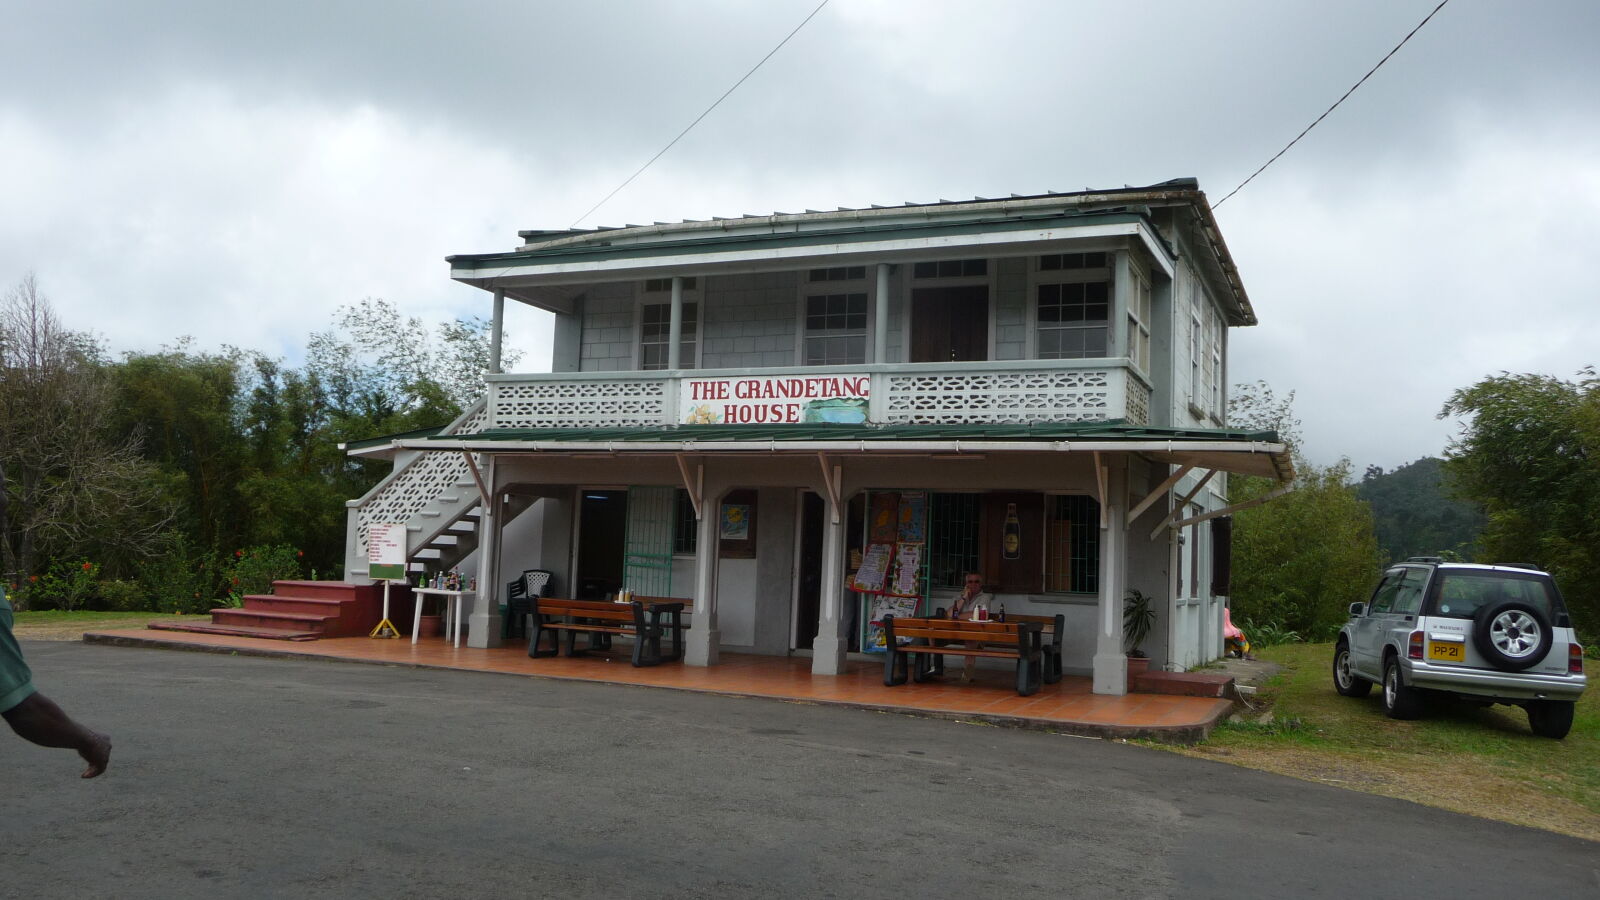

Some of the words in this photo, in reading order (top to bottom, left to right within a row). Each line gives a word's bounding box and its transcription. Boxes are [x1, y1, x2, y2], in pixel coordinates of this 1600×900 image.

[690, 380, 730, 400] THE
[723, 403, 800, 424] HOUSE
[1434, 646, 1447, 656] PP
[1448, 647, 1458, 657] 21
